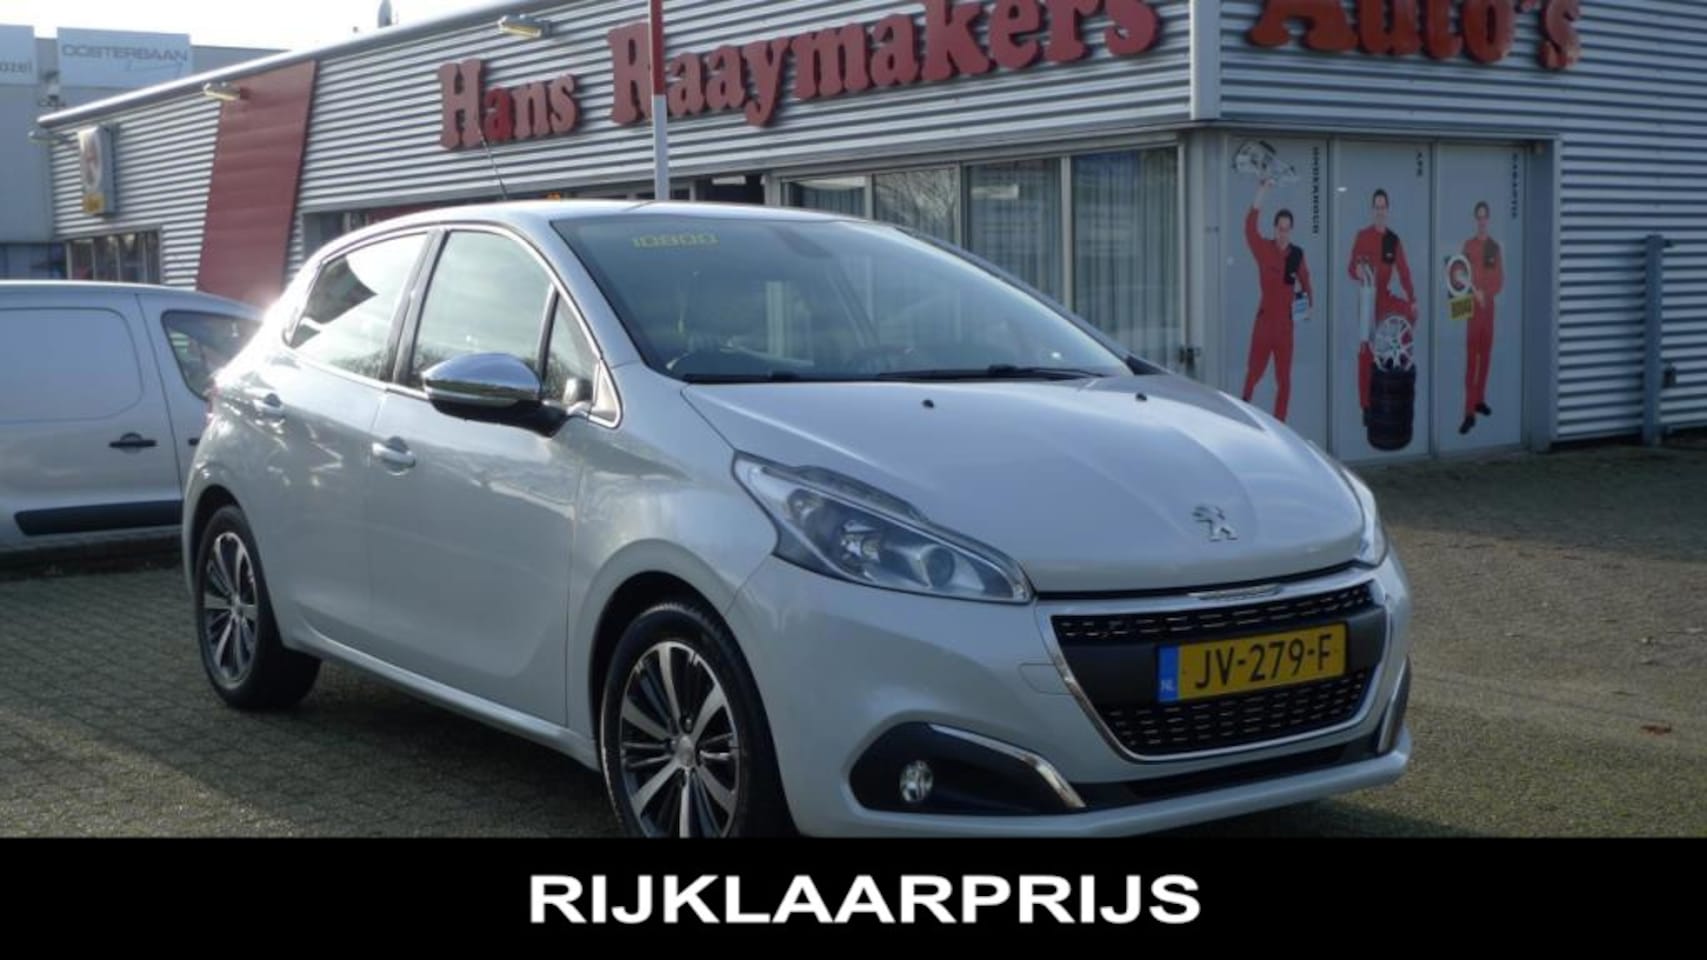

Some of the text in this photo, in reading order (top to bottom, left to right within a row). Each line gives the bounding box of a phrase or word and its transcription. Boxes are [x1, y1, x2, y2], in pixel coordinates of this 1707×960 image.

[62, 43, 188, 62] OOSTERBAAN
[438, 0, 1163, 151] Hans Raaymakers
[1195, 633, 1333, 690] JV-279-F
[1160, 679, 1175, 692] NL
